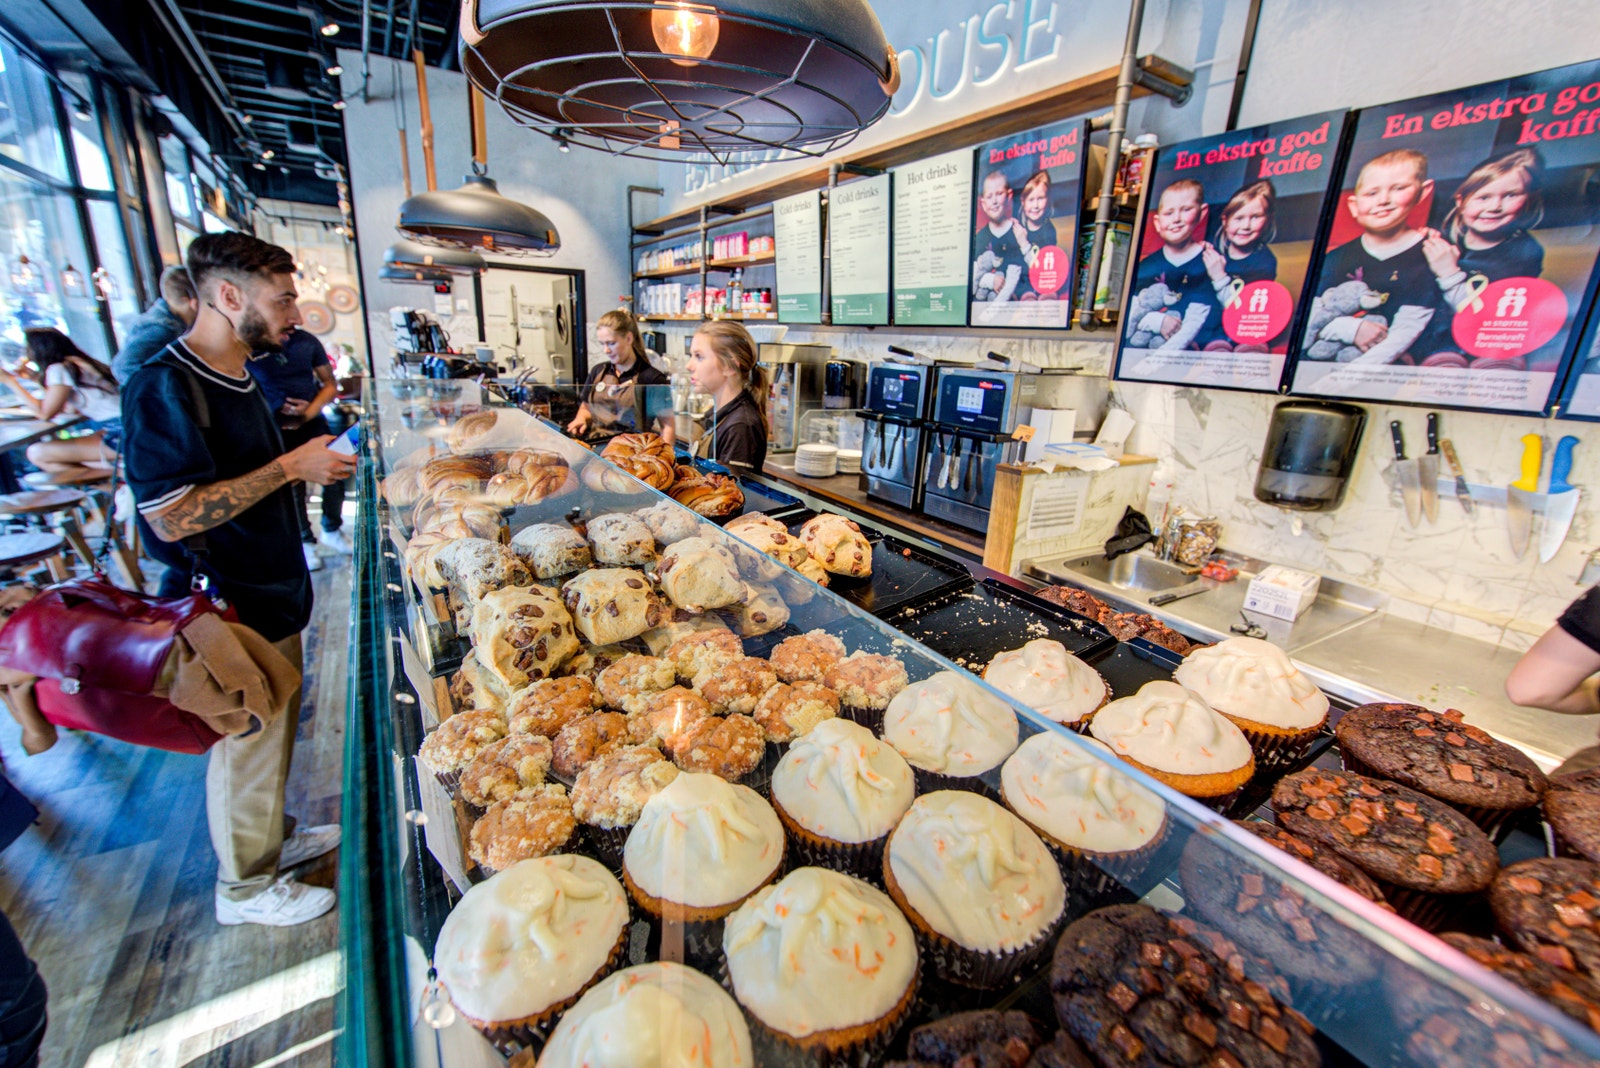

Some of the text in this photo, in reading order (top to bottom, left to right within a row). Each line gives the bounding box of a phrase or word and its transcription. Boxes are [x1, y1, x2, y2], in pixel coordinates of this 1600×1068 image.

[888, 0, 1062, 118] OUSE
[1381, 82, 1600, 139] En ekstra go
[1516, 109, 1600, 145] kaff
[989, 127, 1078, 165] En ekstra god
[1039, 148, 1076, 170] kaffe
[1174, 151, 1201, 170] En
[1205, 137, 1275, 165] ekstra
[1279, 121, 1331, 155] god
[907, 163, 957, 186] Hot drinks
[1257, 150, 1323, 178] kaffe
[779, 199, 811, 216] Cold drinks
[837, 186, 879, 205] Cold drinks
